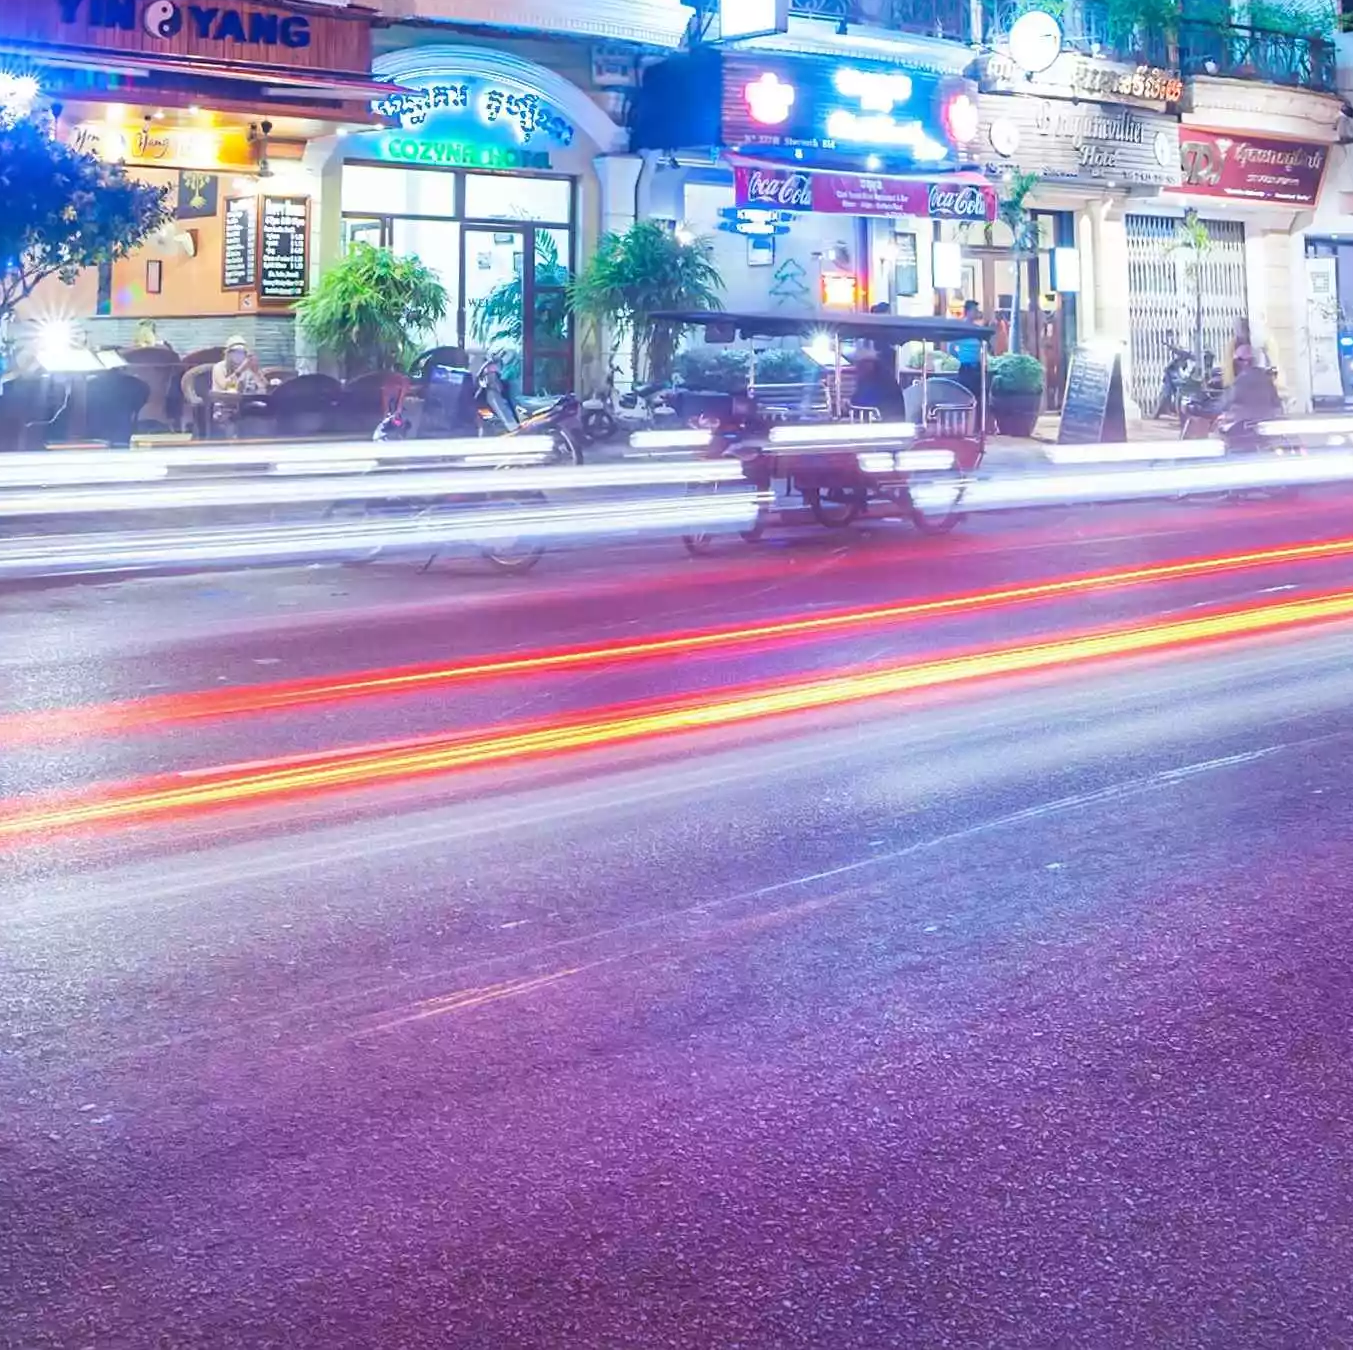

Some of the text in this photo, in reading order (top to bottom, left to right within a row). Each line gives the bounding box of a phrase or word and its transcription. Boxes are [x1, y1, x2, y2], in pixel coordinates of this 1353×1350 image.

[187, 4, 312, 49] YANG
[1079, 144, 1119, 167] Hotel
[748, 169, 812, 207] Coca-Cola
[928, 183, 986, 218] Coca-Cola
